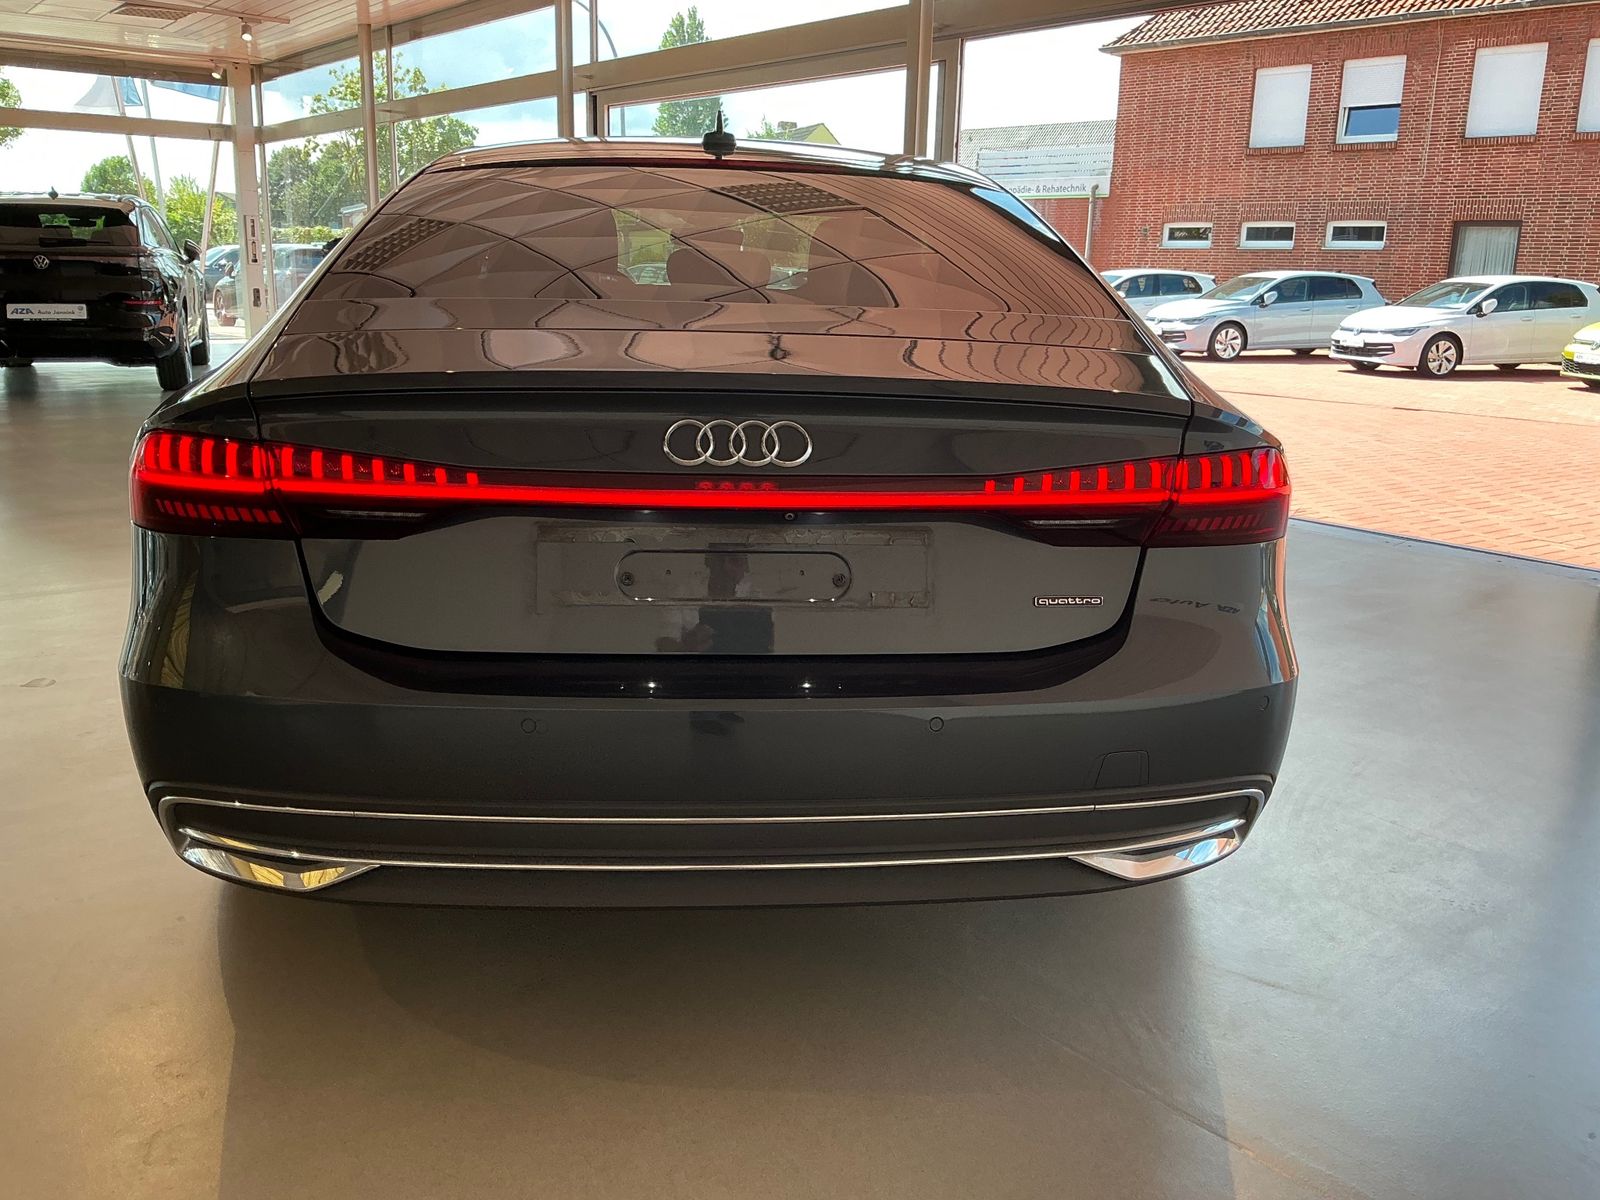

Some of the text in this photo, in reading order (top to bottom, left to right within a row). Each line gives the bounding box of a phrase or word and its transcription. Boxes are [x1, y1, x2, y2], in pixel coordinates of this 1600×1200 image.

[1035, 185, 1042, 194] &
[1042, 183, 1087, 194] Rehatechnik
[10, 307, 35, 315] AZA
[1038, 597, 1101, 606] quattro
